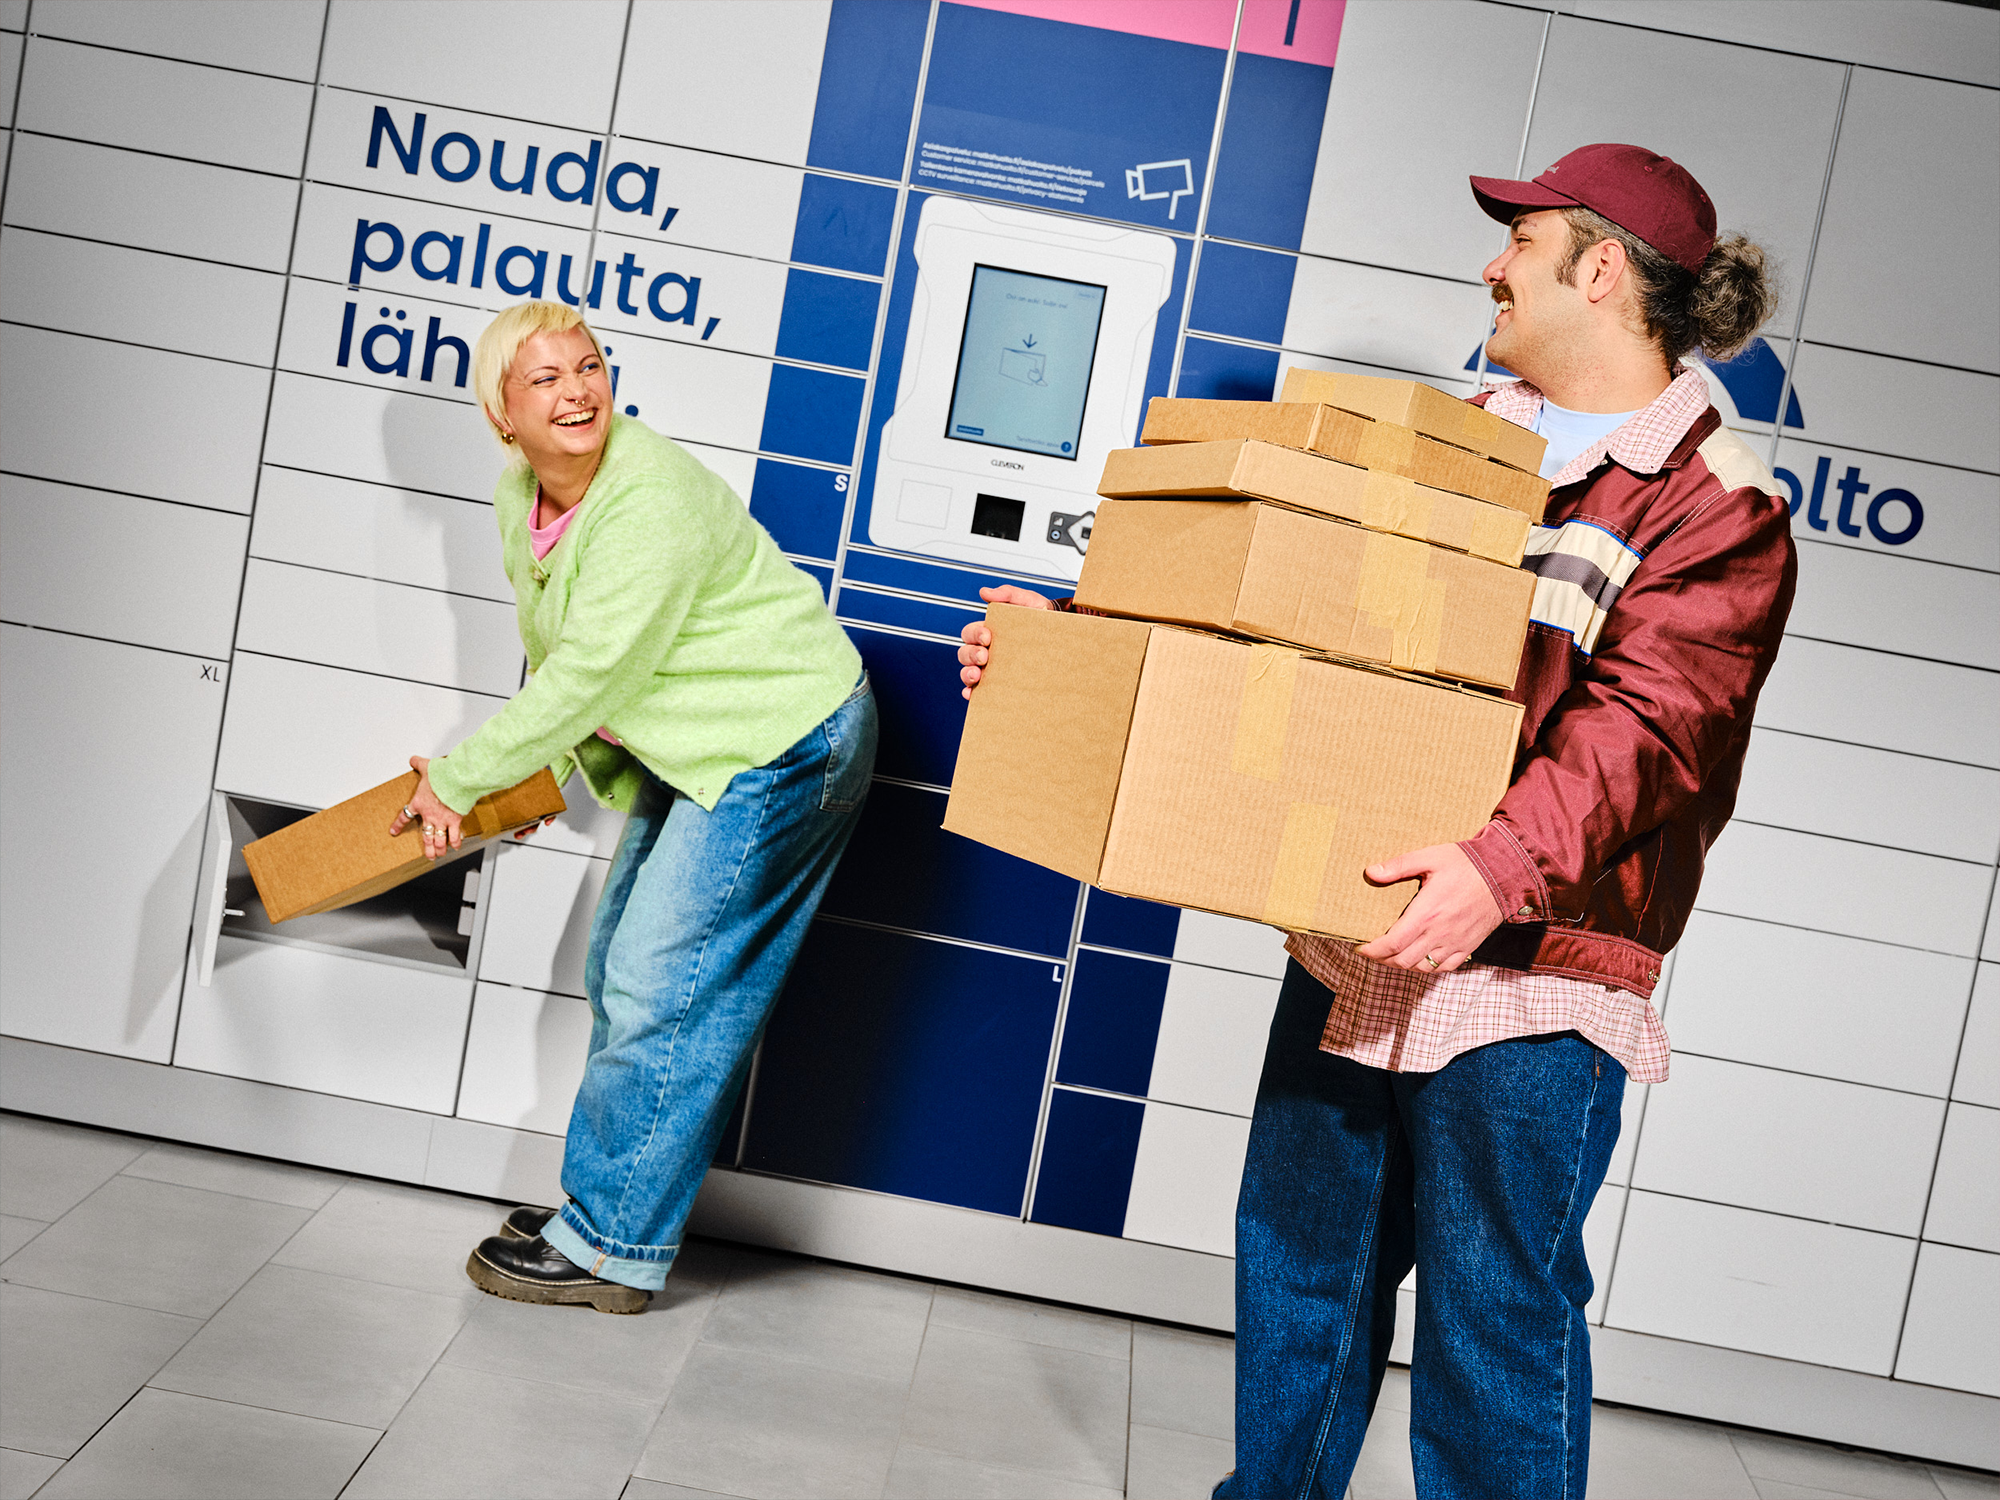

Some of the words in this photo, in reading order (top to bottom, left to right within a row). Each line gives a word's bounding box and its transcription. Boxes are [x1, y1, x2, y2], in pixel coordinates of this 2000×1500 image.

[366, 105, 680, 231] Nouda,
[918, 169, 936, 177] CCTV
[348, 218, 721, 341] palauta,
[834, 474, 849, 492] S
[200, 664, 220, 683] XL
[1052, 965, 1063, 983] L
